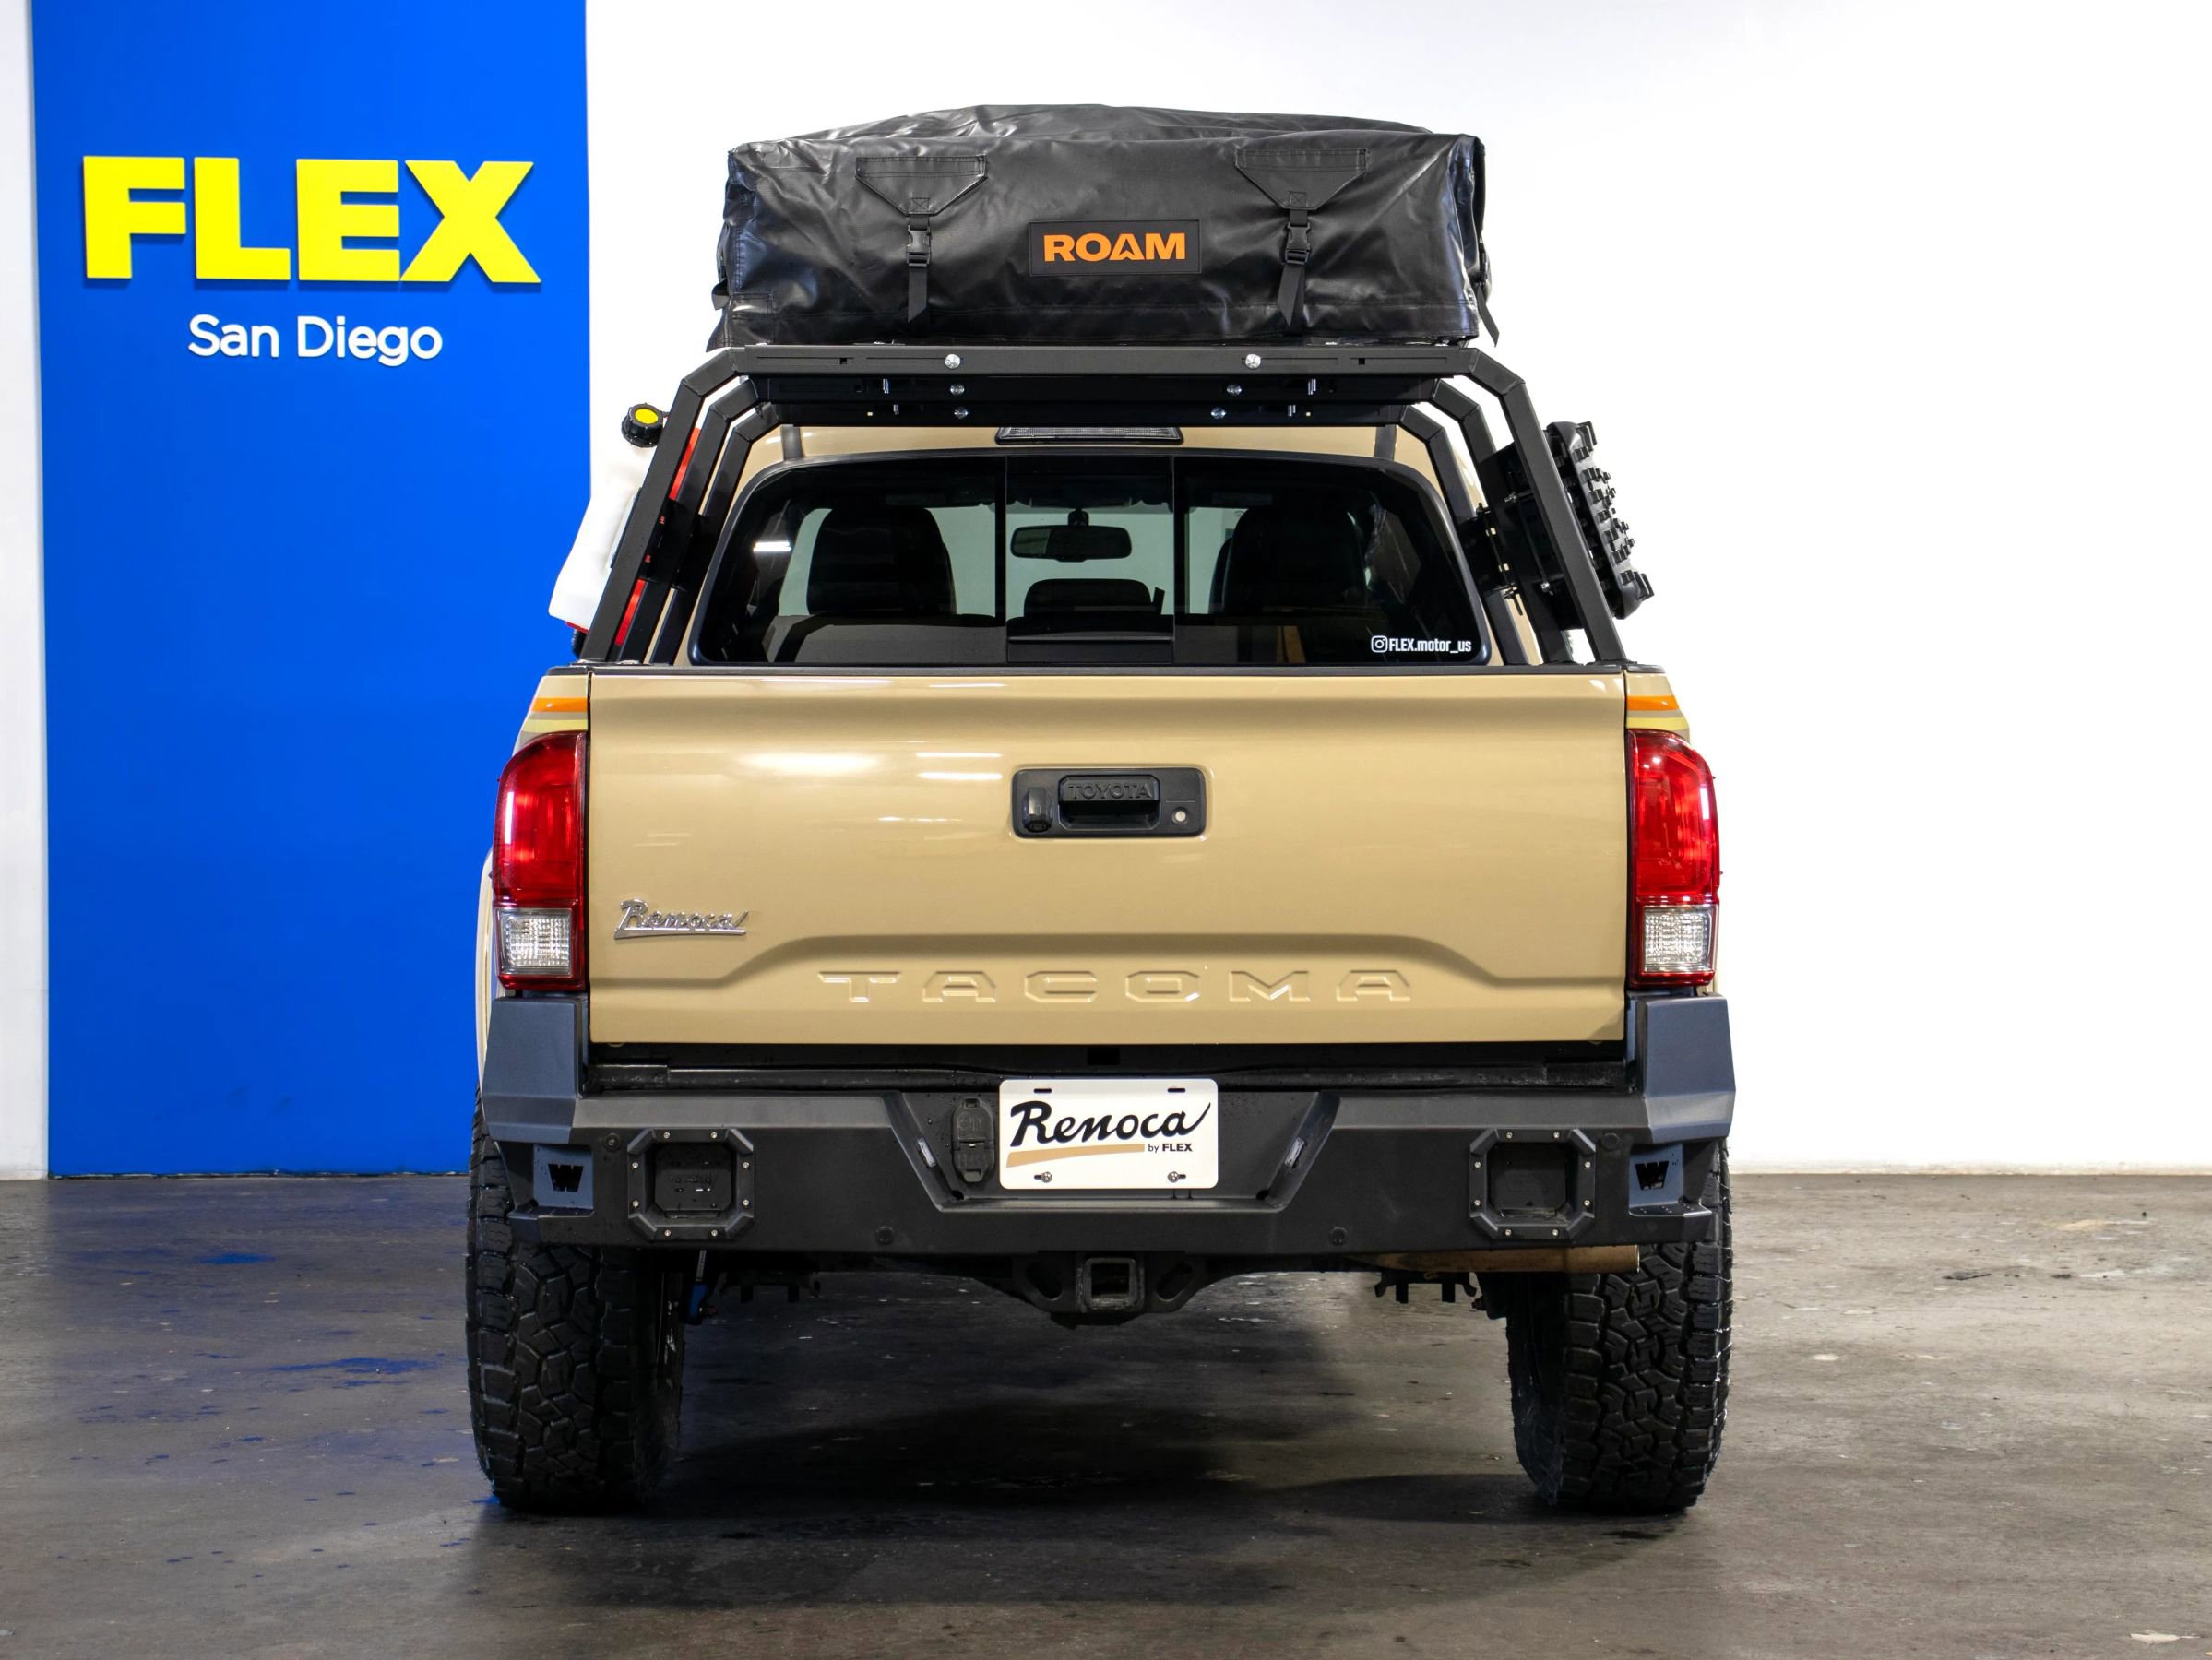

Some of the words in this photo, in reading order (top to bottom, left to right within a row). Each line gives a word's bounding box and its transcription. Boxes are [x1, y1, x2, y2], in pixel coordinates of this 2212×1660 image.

[83, 156, 541, 284] FLEX
[1043, 232, 1186, 262] ROAM
[188, 314, 279, 358] San
[296, 314, 443, 367] Diego
[1388, 637, 1472, 654] FLEX.motor_us
[1067, 782, 1153, 800] TOYOTA
[615, 898, 749, 933] Renoca
[817, 970, 1411, 1003] TACOMA
[1010, 1099, 1211, 1147] Renoca
[1148, 1143, 1160, 1153] by
[1161, 1143, 1194, 1153] FLEX
